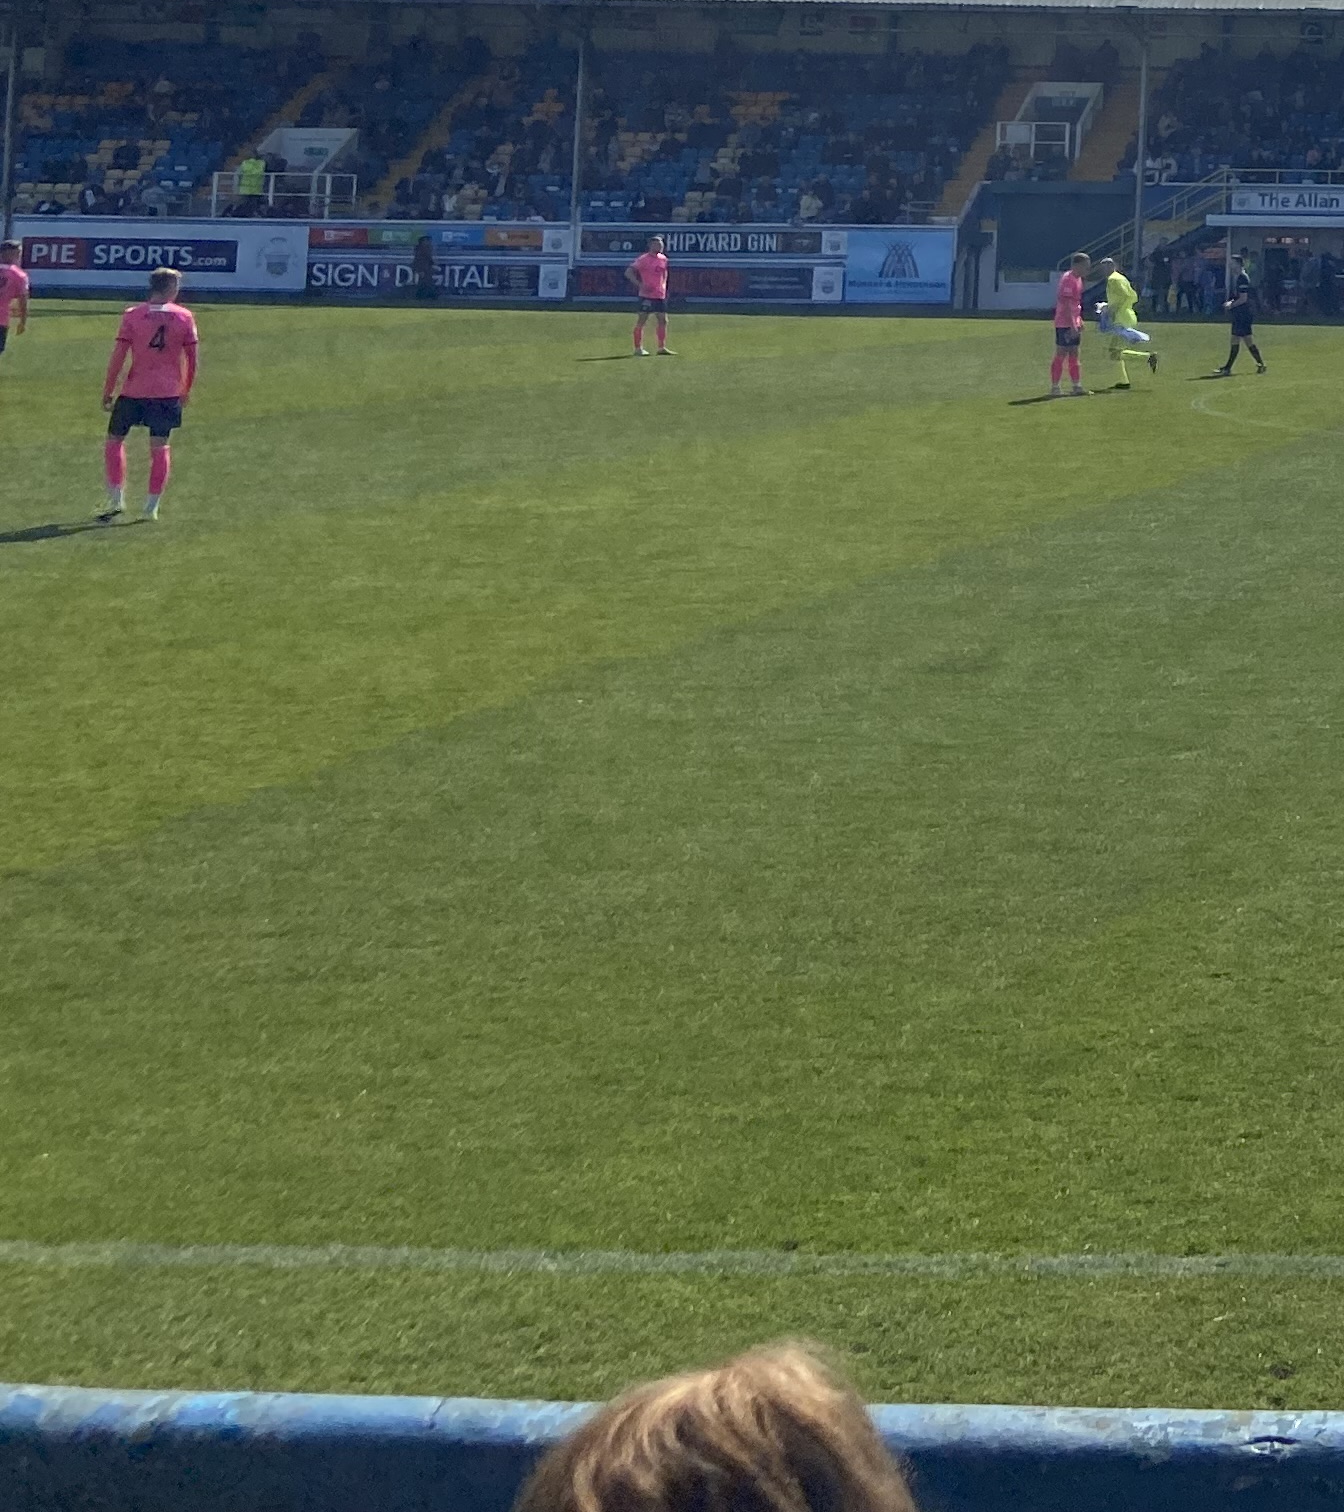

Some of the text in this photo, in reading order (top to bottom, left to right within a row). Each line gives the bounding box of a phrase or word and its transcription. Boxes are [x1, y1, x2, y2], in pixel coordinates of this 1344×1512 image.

[1258, 192, 1290, 208] The
[1295, 193, 1340, 209] Allan
[661, 233, 777, 252] HIPYARD GIN
[31, 243, 77, 264] PIE
[310, 263, 380, 287] SIGN
[148, 325, 166, 351] 4
